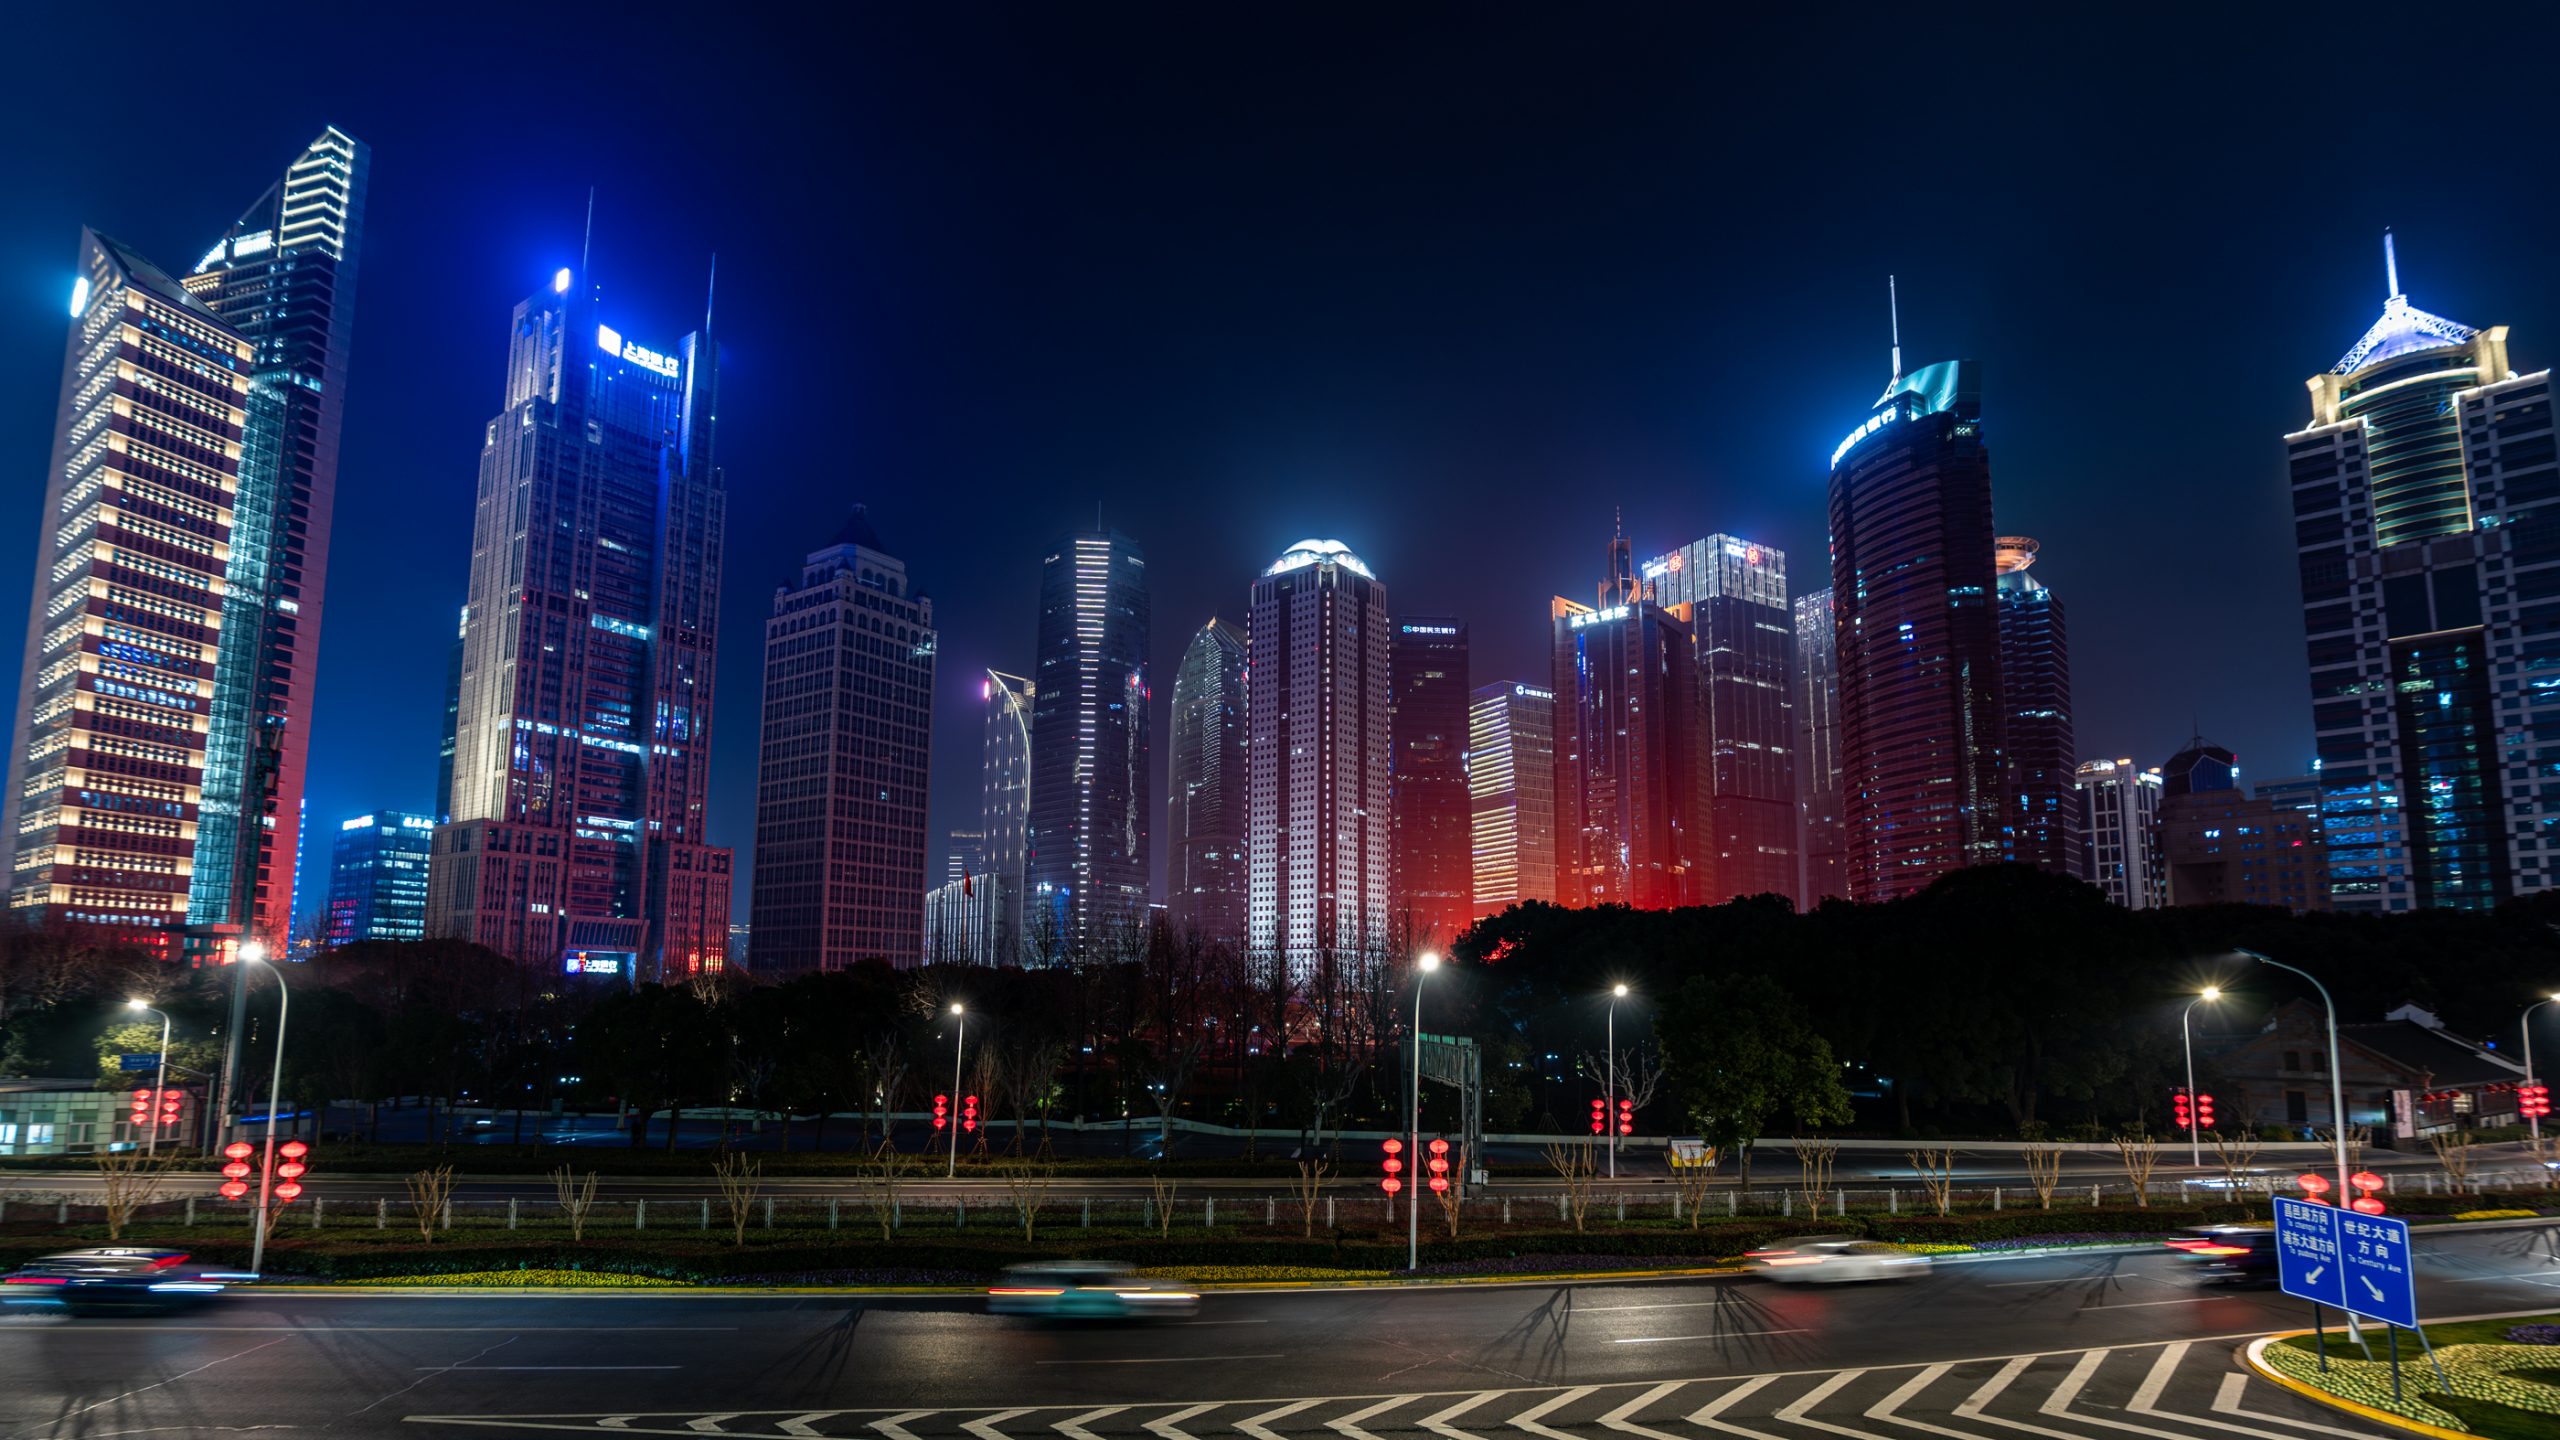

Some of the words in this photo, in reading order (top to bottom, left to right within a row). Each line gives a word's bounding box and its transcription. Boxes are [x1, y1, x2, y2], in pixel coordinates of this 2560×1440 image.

[1412, 626, 1456, 634] 中国民生银行
[2284, 1203, 2329, 1225] 昌邑路方向
[2282, 1230, 2336, 1255] 浦东大道方向
[2343, 1220, 2401, 1244] 世纪大道
[2358, 1257, 2385, 1271] Century
